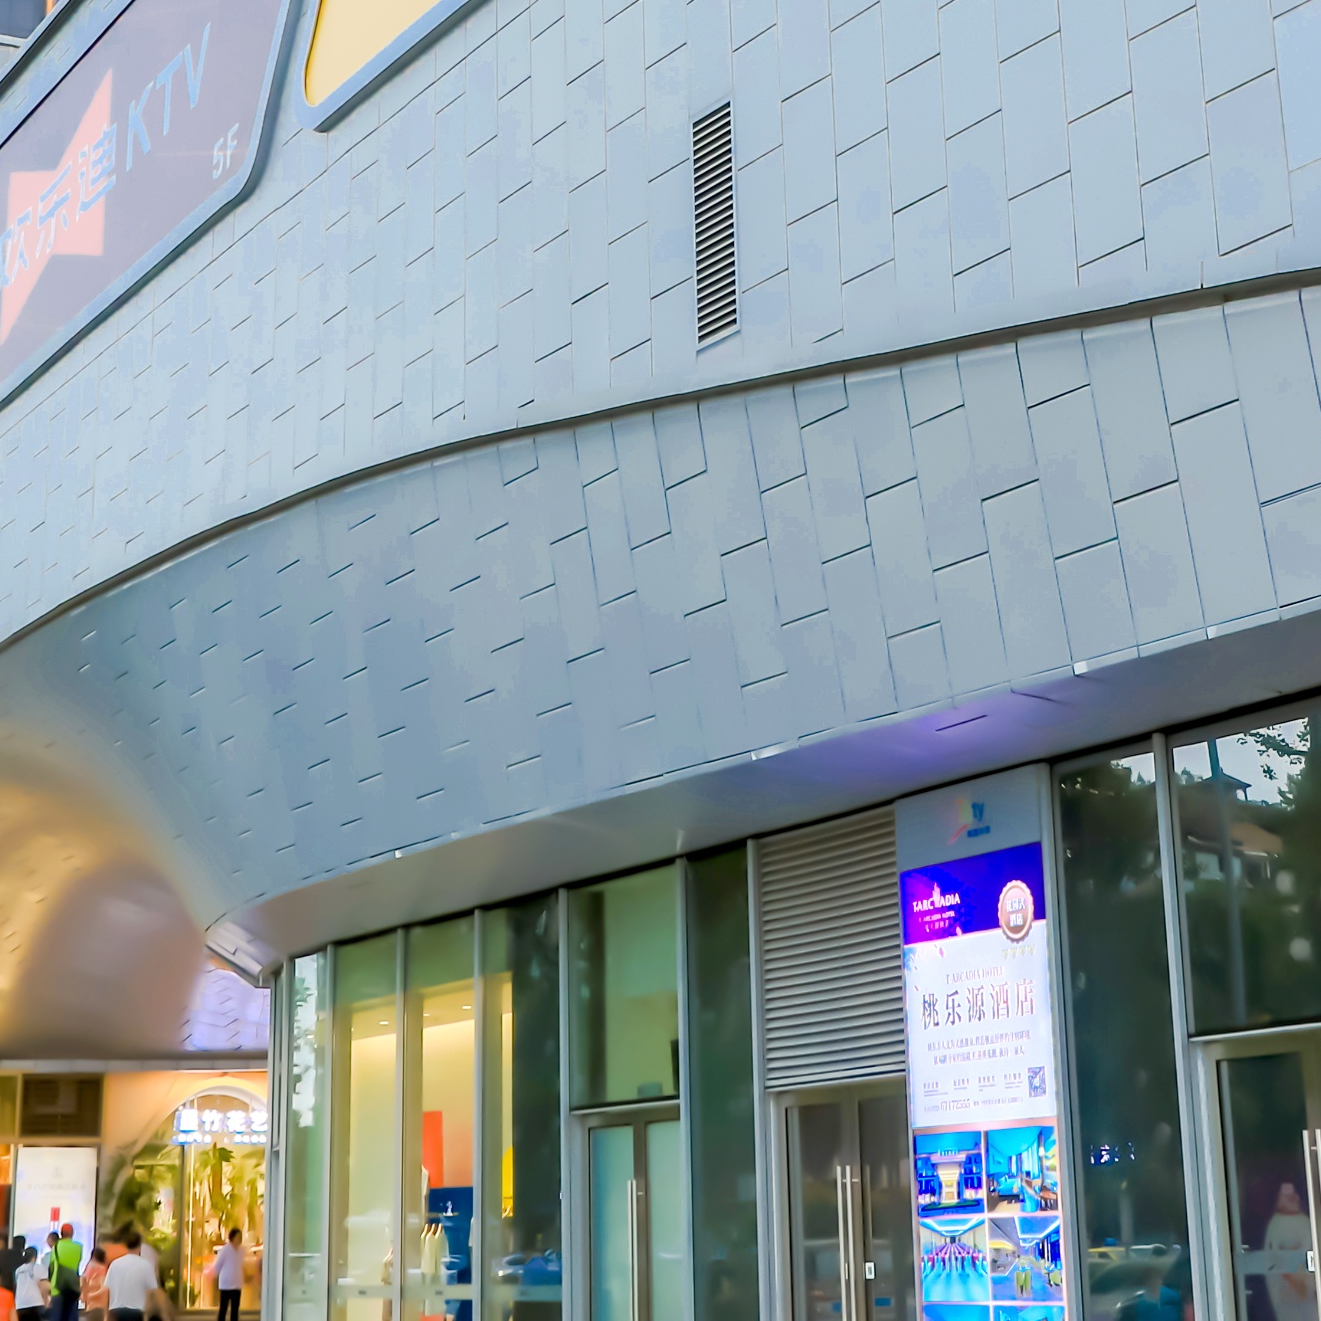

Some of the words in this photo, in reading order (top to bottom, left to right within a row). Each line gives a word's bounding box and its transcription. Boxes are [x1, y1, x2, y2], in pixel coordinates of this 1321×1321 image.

[212, 122, 240, 179] 5F
[921, 978, 1035, 1031] 桃乐源酒店
